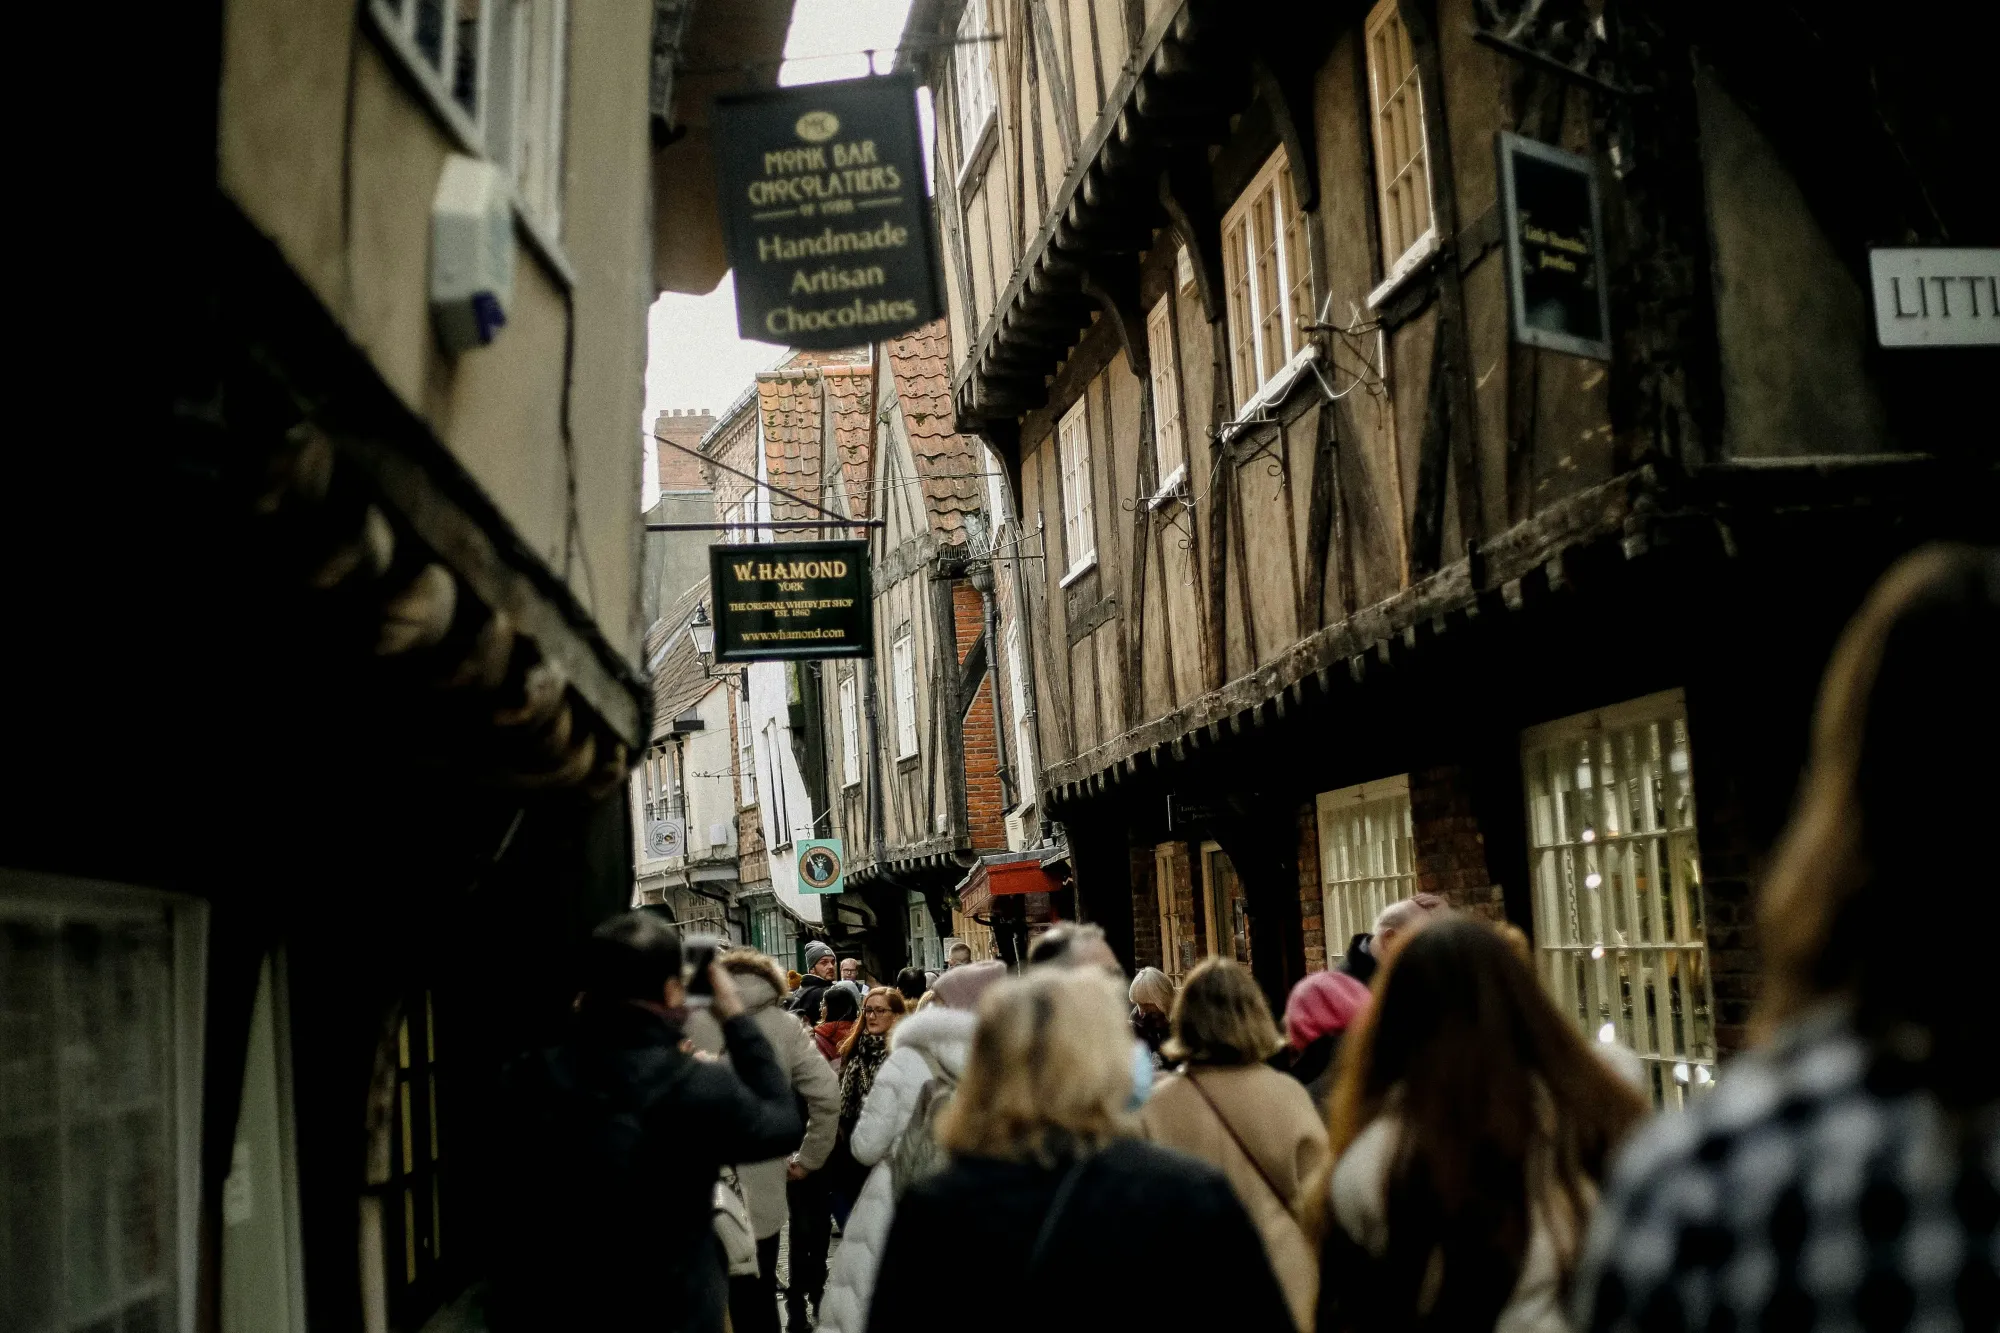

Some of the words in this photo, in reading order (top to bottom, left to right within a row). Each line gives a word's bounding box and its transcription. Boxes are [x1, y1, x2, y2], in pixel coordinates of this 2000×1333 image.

[764, 146, 825, 174] MONK
[833, 141, 877, 166] BAR
[748, 166, 902, 205] CHOCOLATIERS
[757, 222, 908, 262] Handmade
[791, 265, 885, 295] Artisan
[766, 298, 918, 335] Chocolates
[733, 562, 756, 581] W.
[758, 561, 847, 580] HAMOND
[777, 582, 805, 592] YORK
[729, 602, 746, 611] THE
[746, 601, 785, 611] ORIGINAL
[786, 600, 818, 609] WHITBY
[818, 600, 832, 609] JET
[832, 599, 853, 608] SHOP
[792, 609, 810, 617] 1860
[741, 628, 845, 641] www.whamond.com
